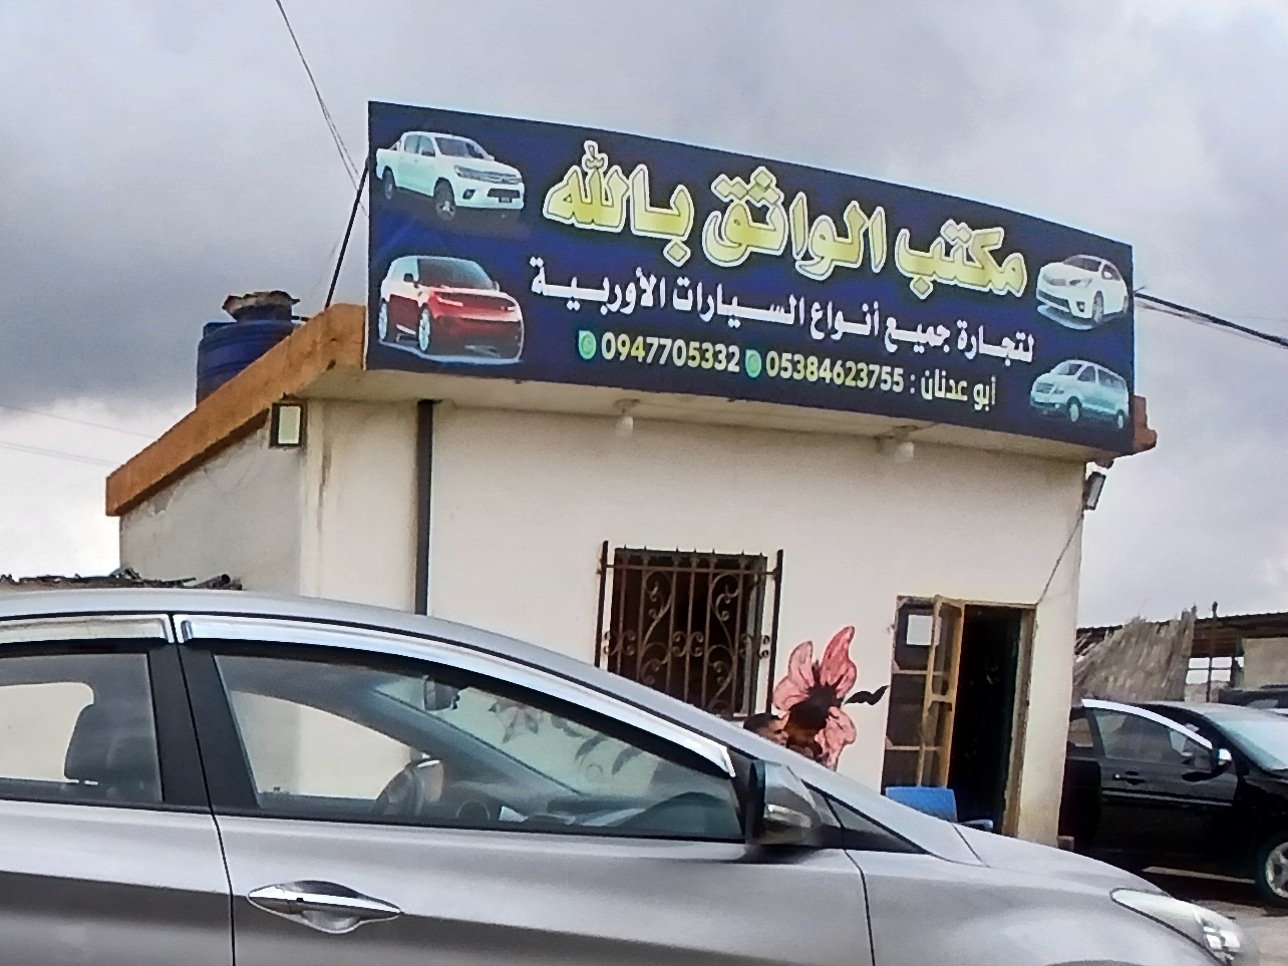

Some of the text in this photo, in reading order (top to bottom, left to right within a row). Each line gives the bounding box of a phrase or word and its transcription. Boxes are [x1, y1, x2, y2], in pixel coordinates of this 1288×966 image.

[542, 140, 1028, 300] مكتب الواثق بالله
[529, 256, 1035, 367] لتجارة جميع أنواع السيارات الأوربية
[601, 331, 741, 373] 0947705332
[765, 350, 905, 394] 05384623755
[920, 368, 968, 402] عدنان
[973, 375, 997, 412] أبو
